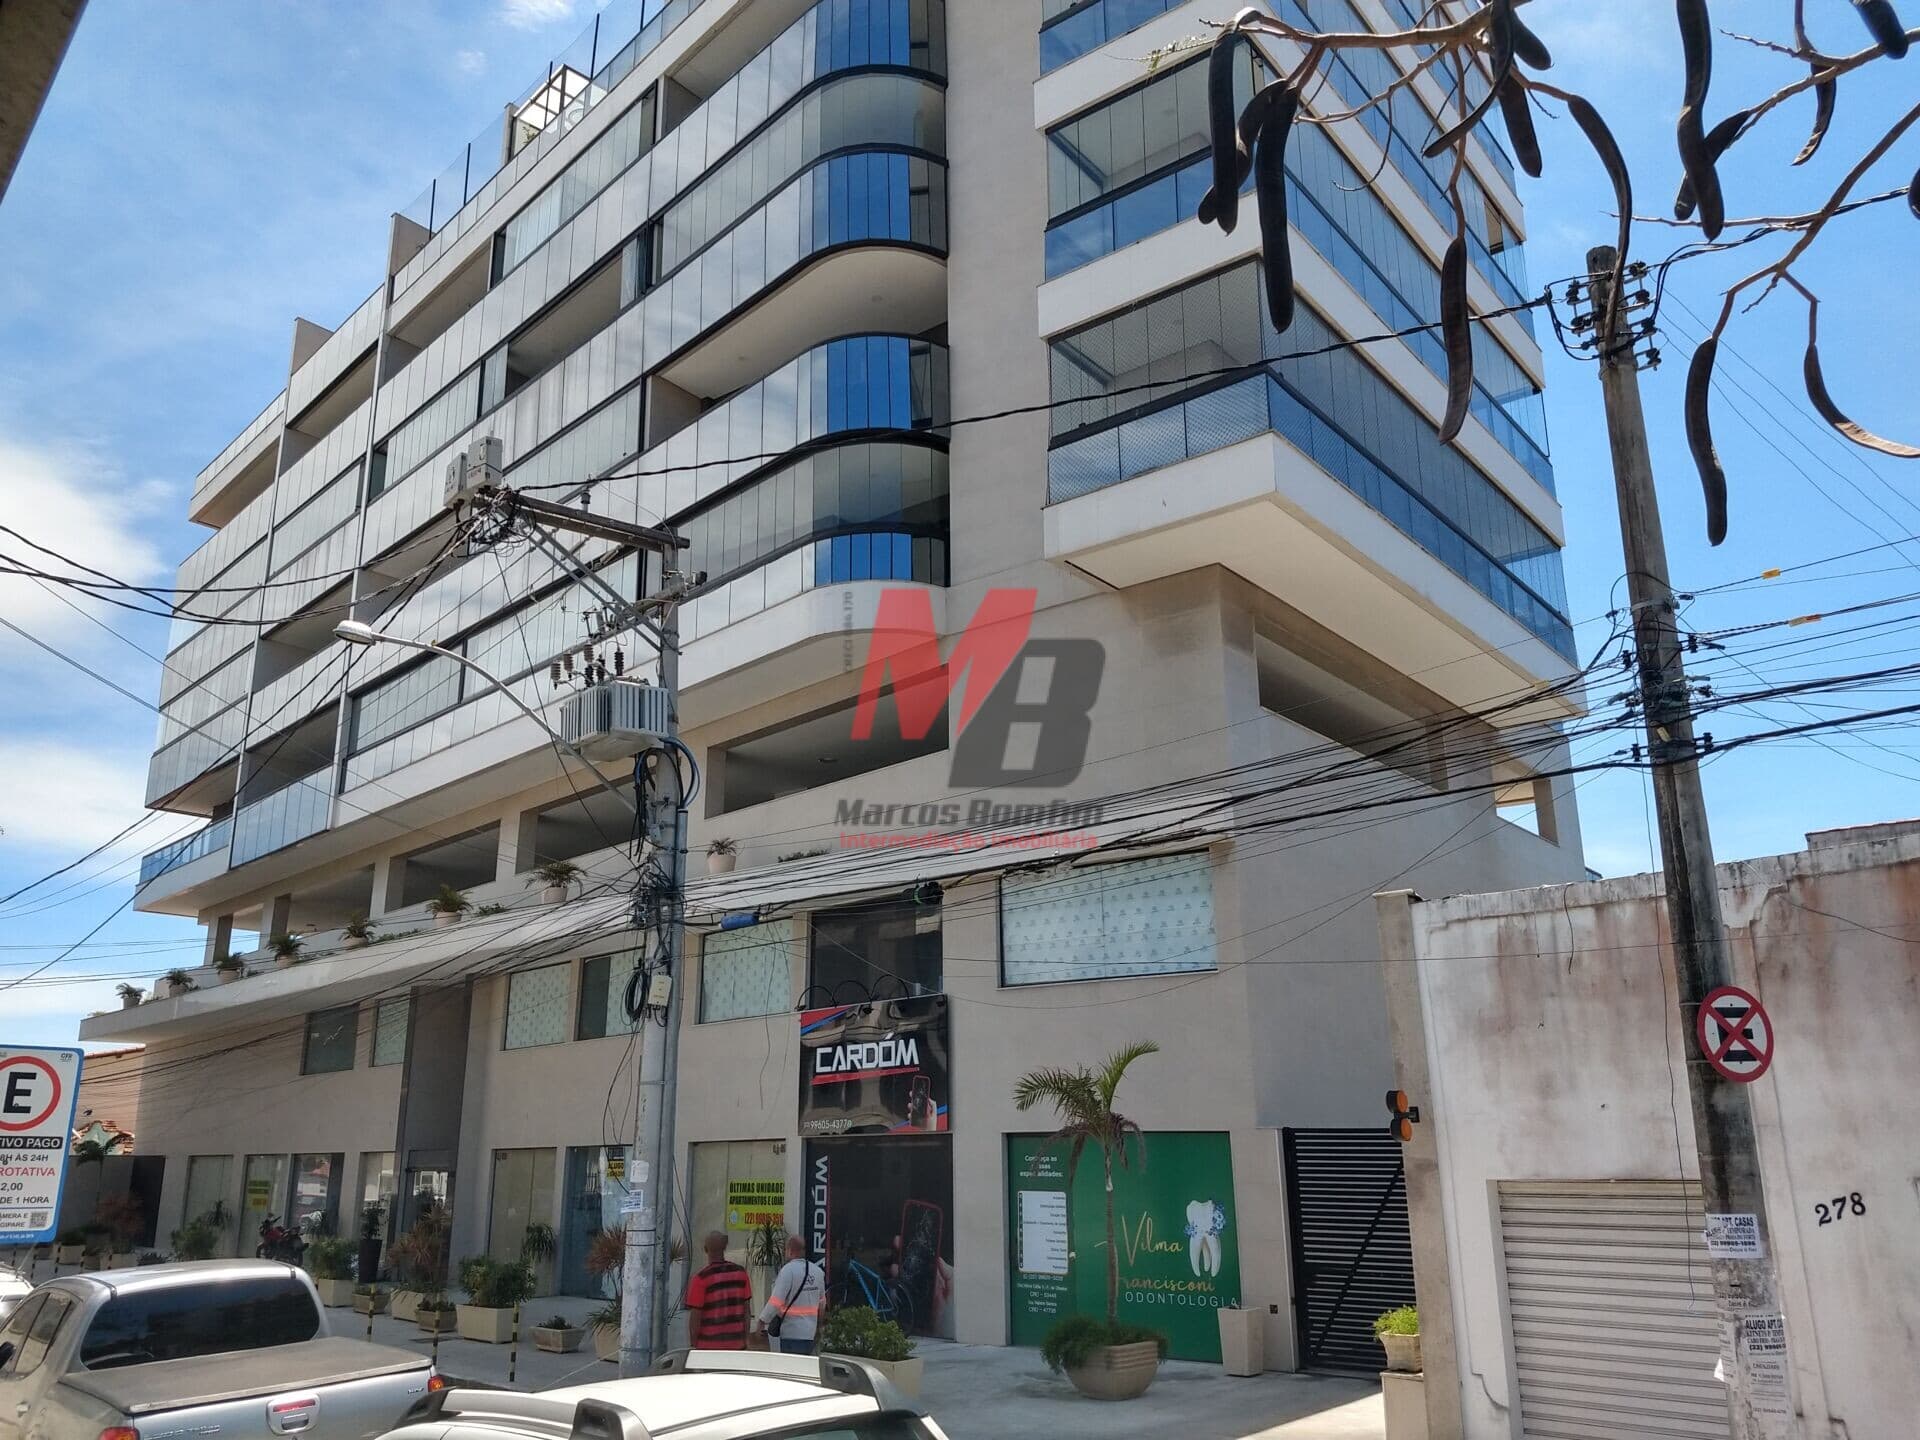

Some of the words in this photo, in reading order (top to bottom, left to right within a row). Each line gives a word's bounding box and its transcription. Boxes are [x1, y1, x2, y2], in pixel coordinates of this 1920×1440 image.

[815, 1031, 919, 1073] CARDÓM
[3, 1072, 37, 1113] E
[26, 1138, 60, 1148] PAGO
[0, 1167, 56, 1177] ROTATIVA
[0, 1182, 23, 1192] 2,00
[0, 1196, 13, 1204] DE
[23, 1196, 50, 1204] HORA
[812, 1155, 828, 1271] ARDÓM
[1814, 1192, 1867, 1227] 278
[1734, 1216, 1754, 1227] CASAS
[1121, 1211, 1184, 1267] Vilma
[1120, 1275, 1215, 1292] rancisconi
[1125, 1291, 1240, 1307] ODONTOLOGIA
[1745, 1319, 1766, 1329] ALUGO
